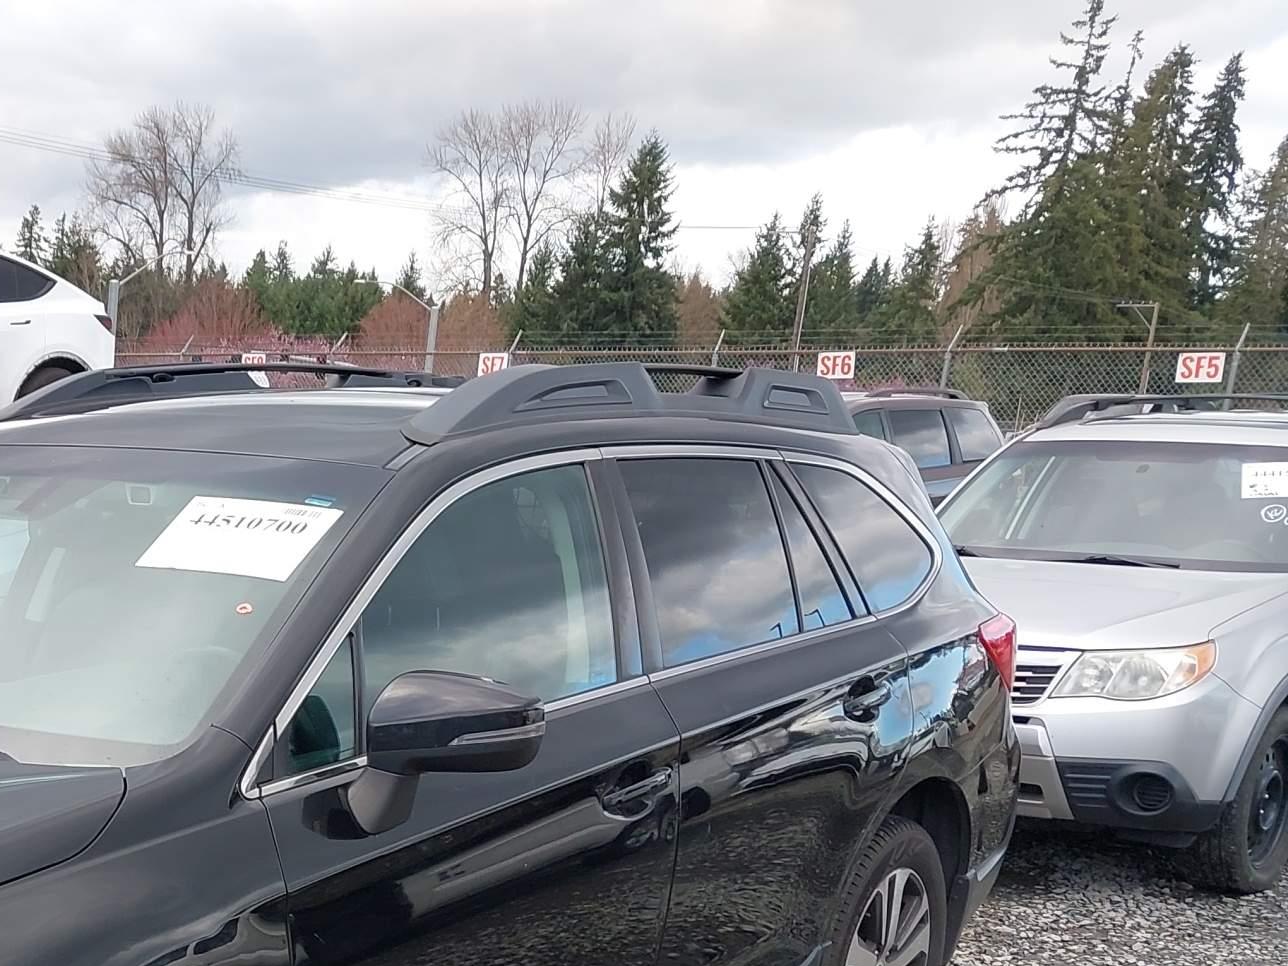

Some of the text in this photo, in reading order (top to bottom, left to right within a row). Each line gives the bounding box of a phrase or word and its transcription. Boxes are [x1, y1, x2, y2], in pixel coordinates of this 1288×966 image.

[481, 355, 505, 375] SF7
[820, 354, 852, 376] SF6
[1181, 355, 1221, 379] SF5
[189, 513, 309, 535] 44510700
